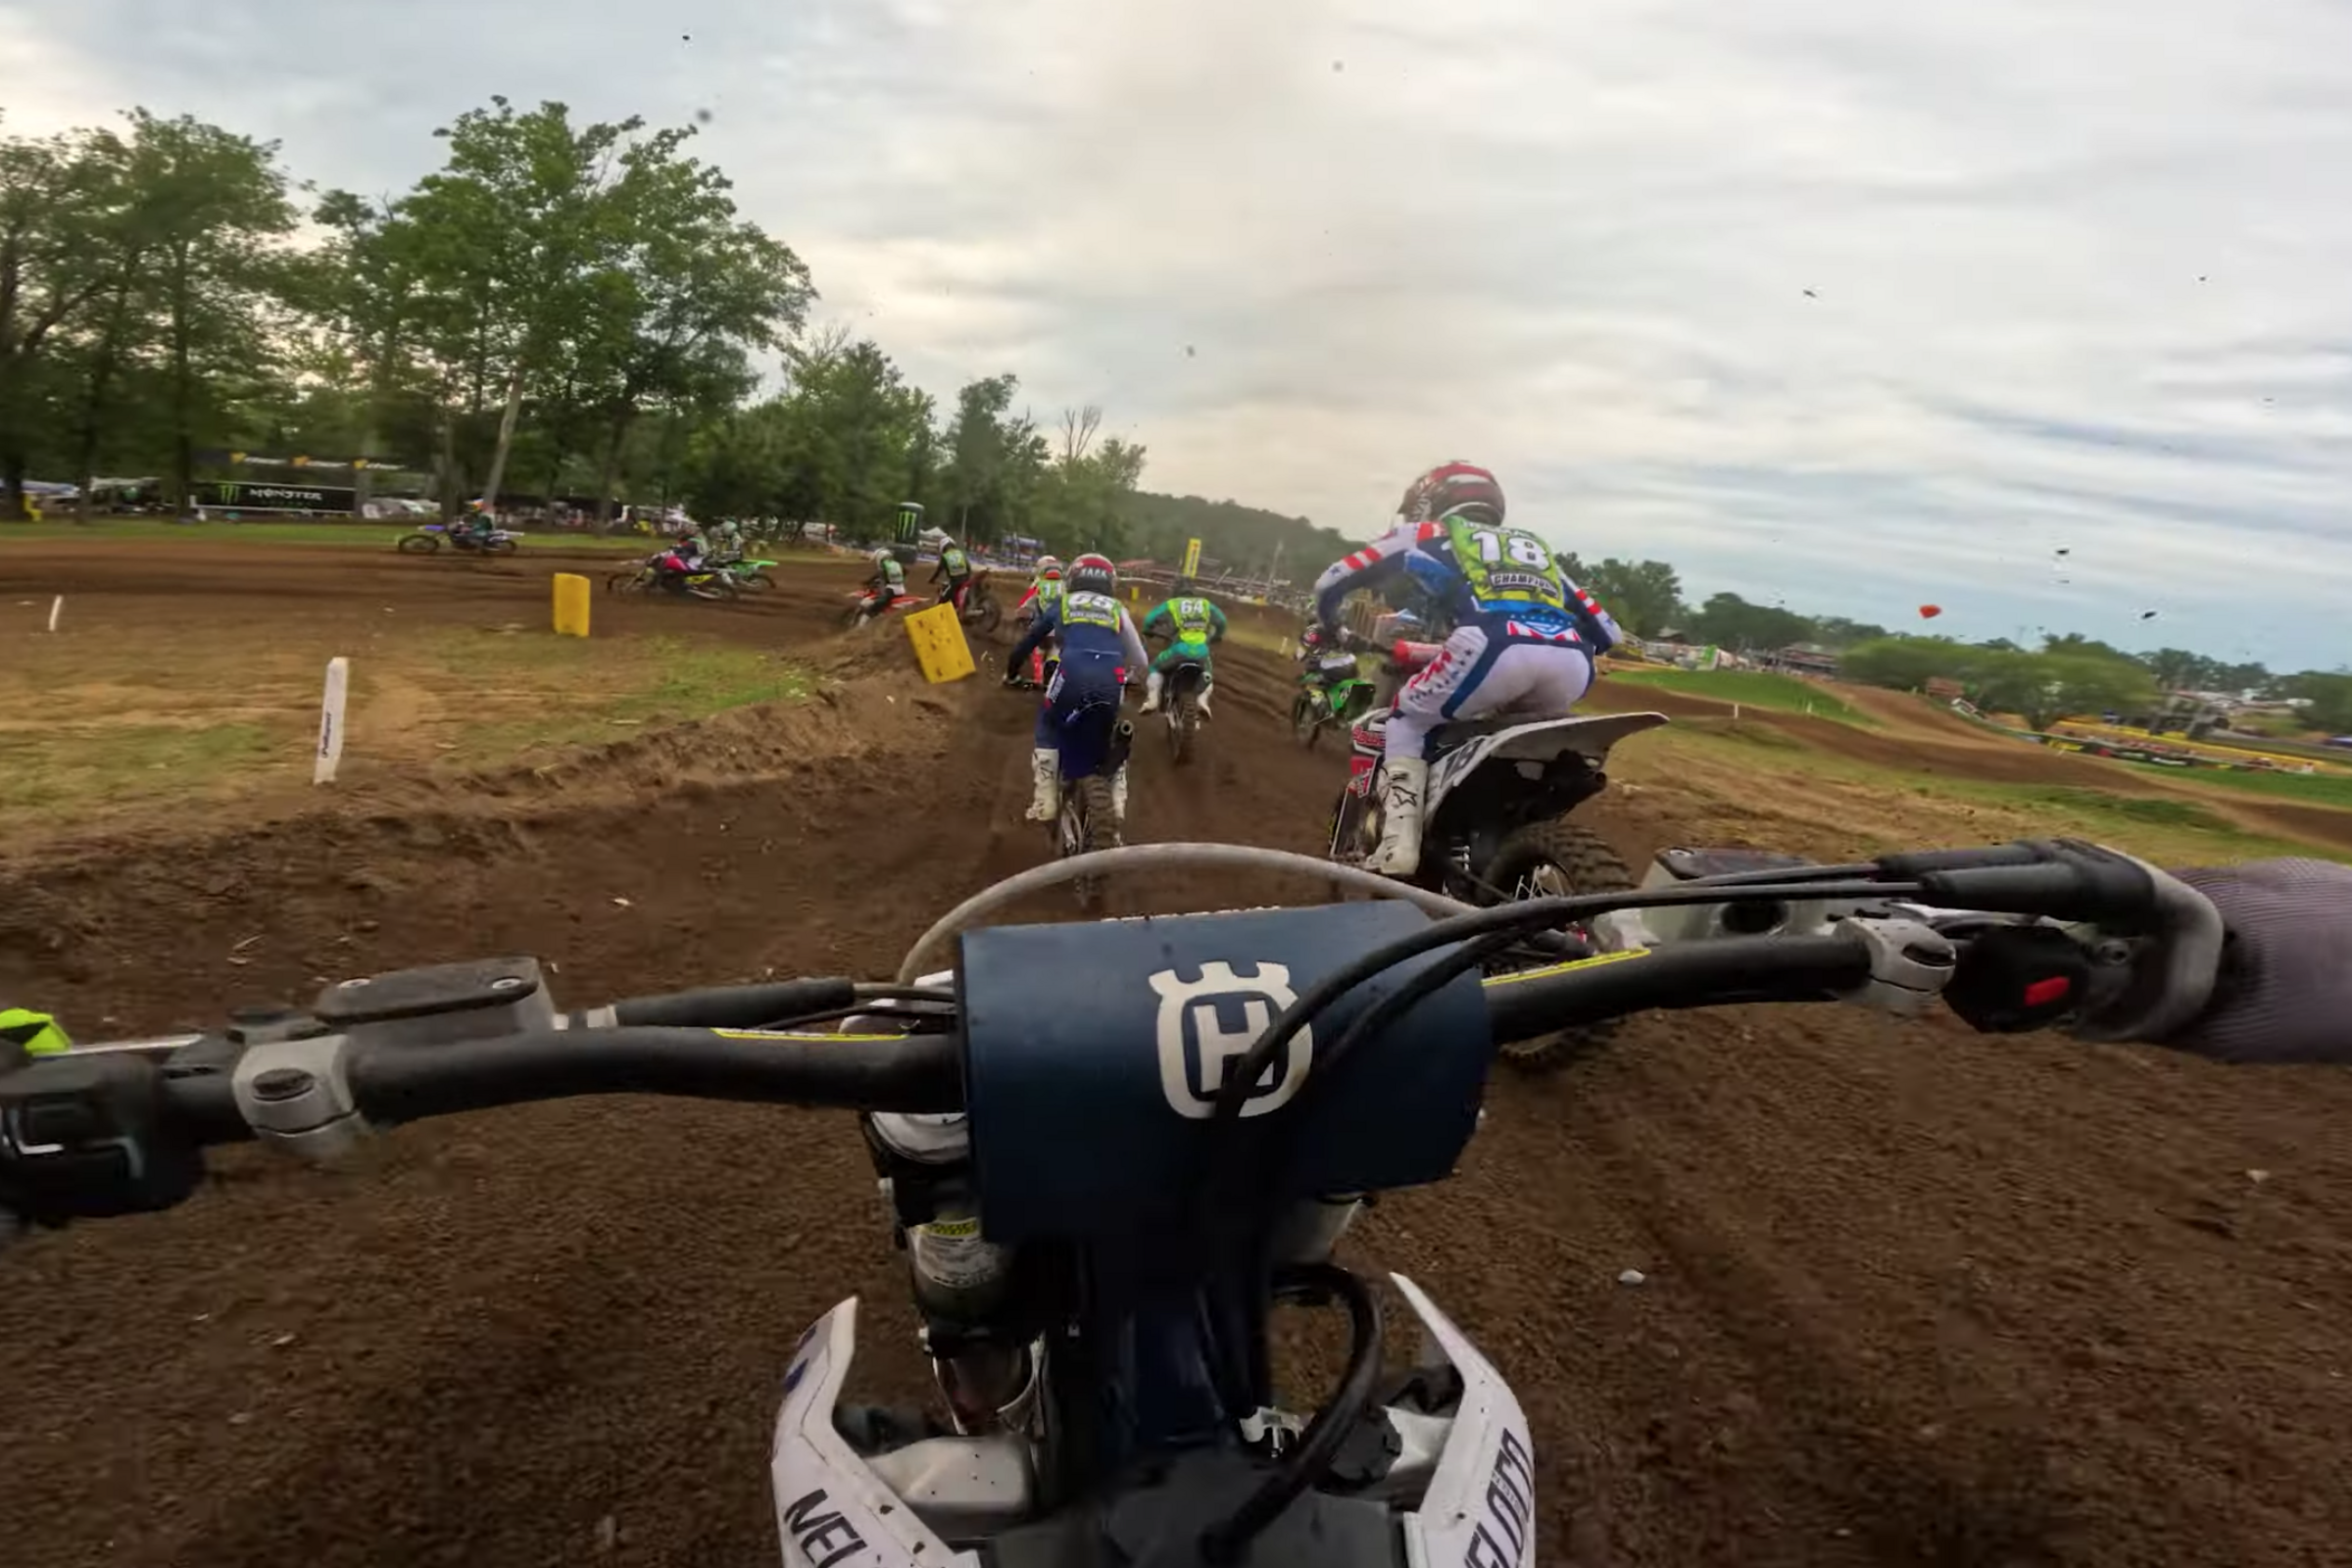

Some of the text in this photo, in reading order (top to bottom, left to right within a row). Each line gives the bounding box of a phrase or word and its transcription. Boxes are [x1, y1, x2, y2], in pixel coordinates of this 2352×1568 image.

[249, 488, 323, 502] MONSTER
[1472, 530, 1549, 570] 18
[1180, 599, 1204, 614] 64
